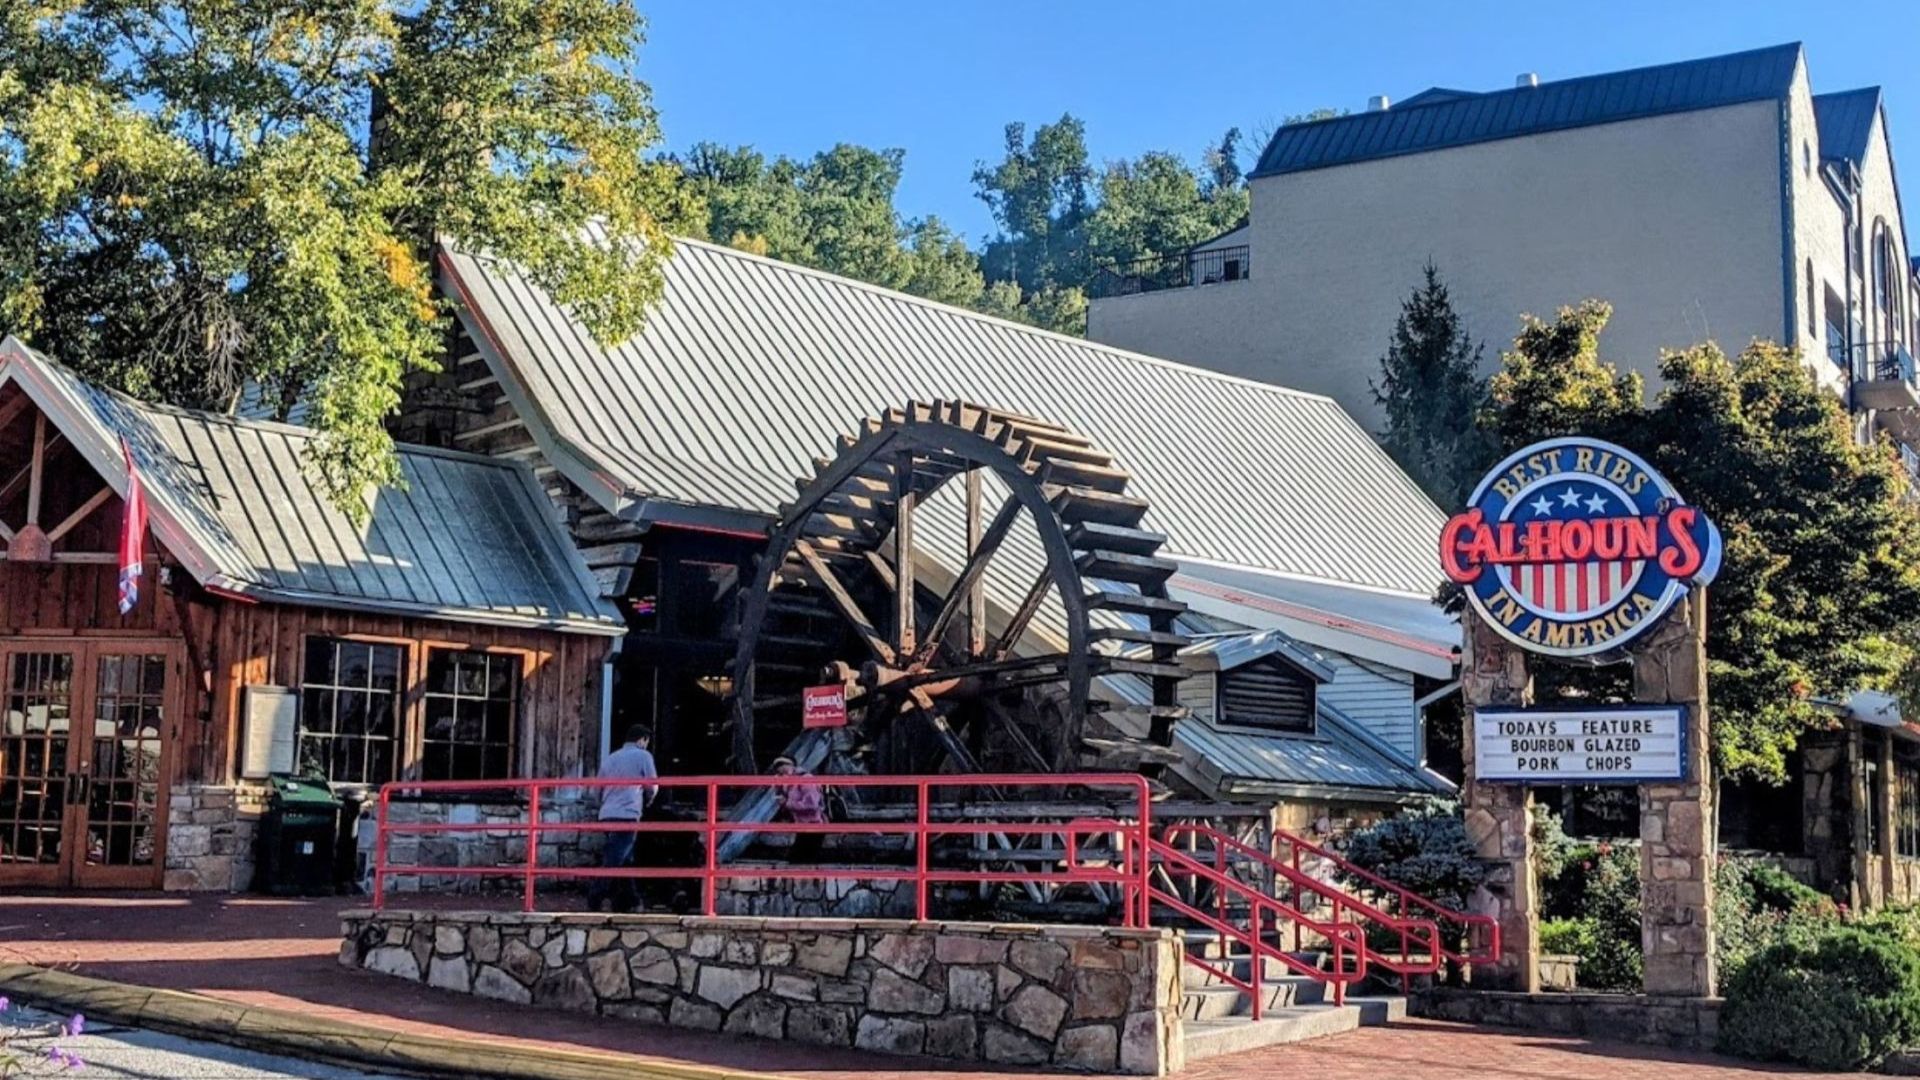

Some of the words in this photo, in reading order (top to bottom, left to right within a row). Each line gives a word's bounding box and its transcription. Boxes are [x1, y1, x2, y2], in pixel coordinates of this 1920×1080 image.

[1492, 449, 1563, 501] BEST
[1574, 447, 1650, 495] RIBS
[1440, 500, 1701, 583] CALHOUN'S
[1484, 588, 1525, 622] IN
[1520, 593, 1660, 648] AMERICA
[1498, 720, 1557, 735] TODAYS
[1582, 719, 1653, 735] FEATURE
[1511, 739, 1574, 752] BOURBON
[1584, 738, 1641, 751] GLAZED
[1518, 757, 1559, 770] PORK
[1585, 757, 1632, 770] CHOPS
